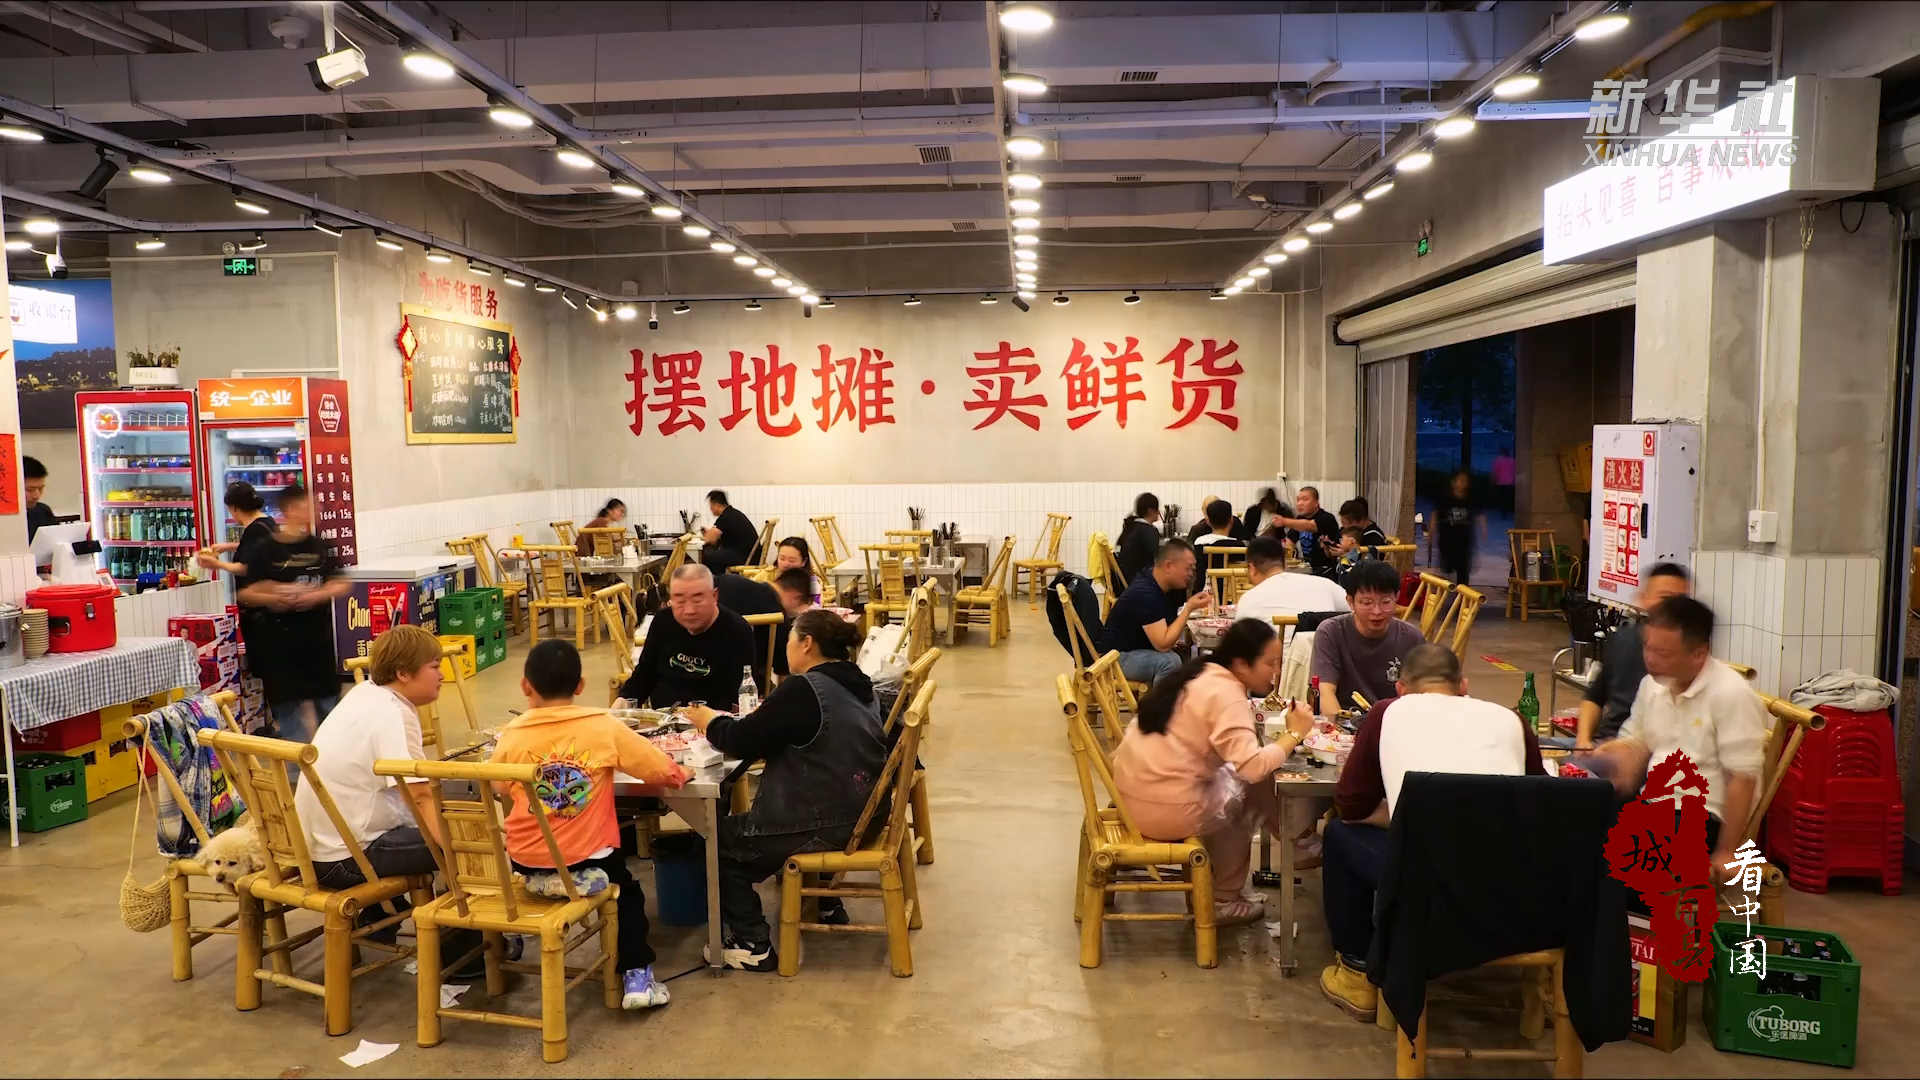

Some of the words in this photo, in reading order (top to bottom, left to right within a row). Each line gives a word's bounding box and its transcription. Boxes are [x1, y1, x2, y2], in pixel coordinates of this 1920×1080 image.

[1556, 174, 1638, 241] 抬头见喜
[210, 389, 293, 407] 统一企业
[1606, 460, 1641, 487] 消火栓
[320, 510, 337, 521] 1664
[1757, 1015, 1821, 1035] TUBORG
